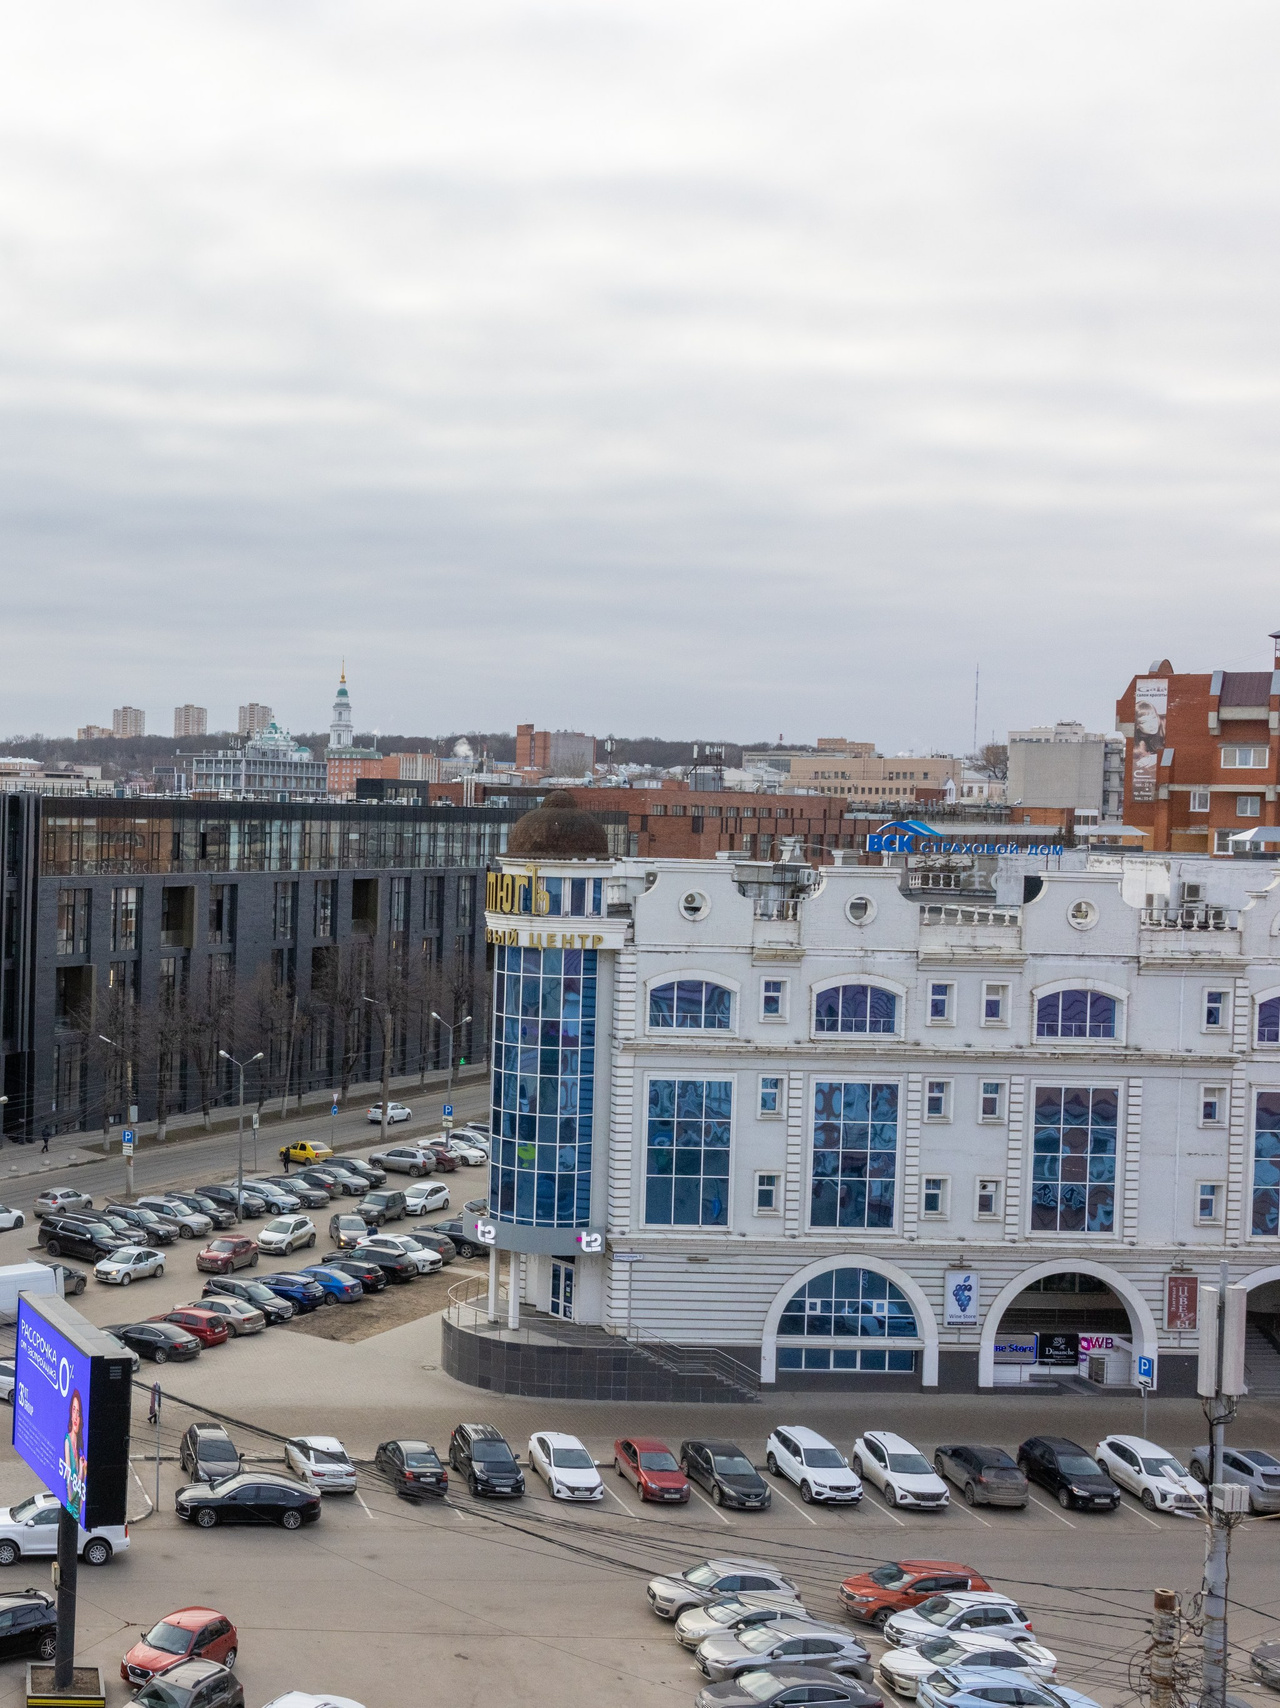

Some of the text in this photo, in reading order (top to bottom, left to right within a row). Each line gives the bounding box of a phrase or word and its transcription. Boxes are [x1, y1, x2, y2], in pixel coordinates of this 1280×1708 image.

[867, 834, 1064, 856] ВСК СТРАХОВОЙ ДОМ
[528, 932, 604, 950] ЦЕНТР
[475, 1220, 497, 1245] t2
[576, 1231, 602, 1253] t2
[21, 1319, 57, 1365] РАССРОЧКА
[1008, 1343, 1035, 1353] Store
[1045, 1347, 1075, 1355] Dimanche
[1089, 1337, 1114, 1349] WB
[20, 1339, 57, 1380] от застройщика
[59, 1457, 87, 1502] 577-843
